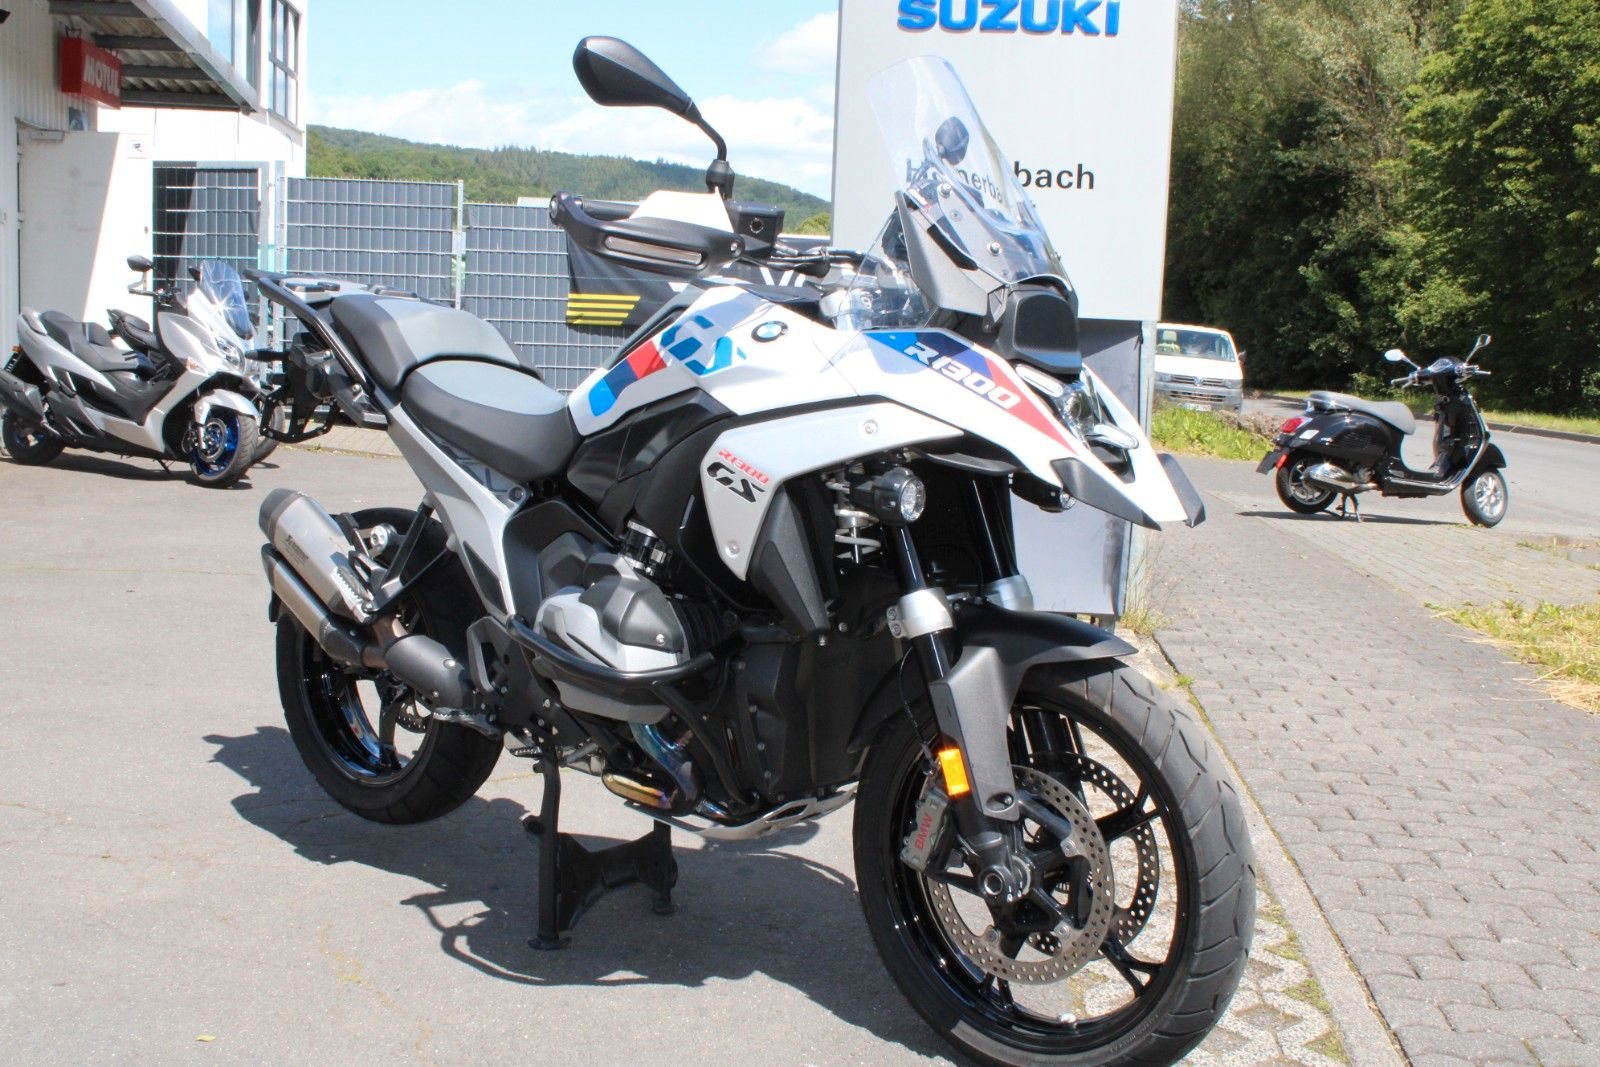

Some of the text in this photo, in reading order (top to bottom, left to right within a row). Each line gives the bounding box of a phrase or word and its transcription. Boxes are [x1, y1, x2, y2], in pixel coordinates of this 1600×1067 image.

[897, 0, 1120, 36] SUZUKI
[83, 53, 120, 97] MOTUL
[706, 461, 765, 503] GS
[915, 814, 933, 849] BMW
